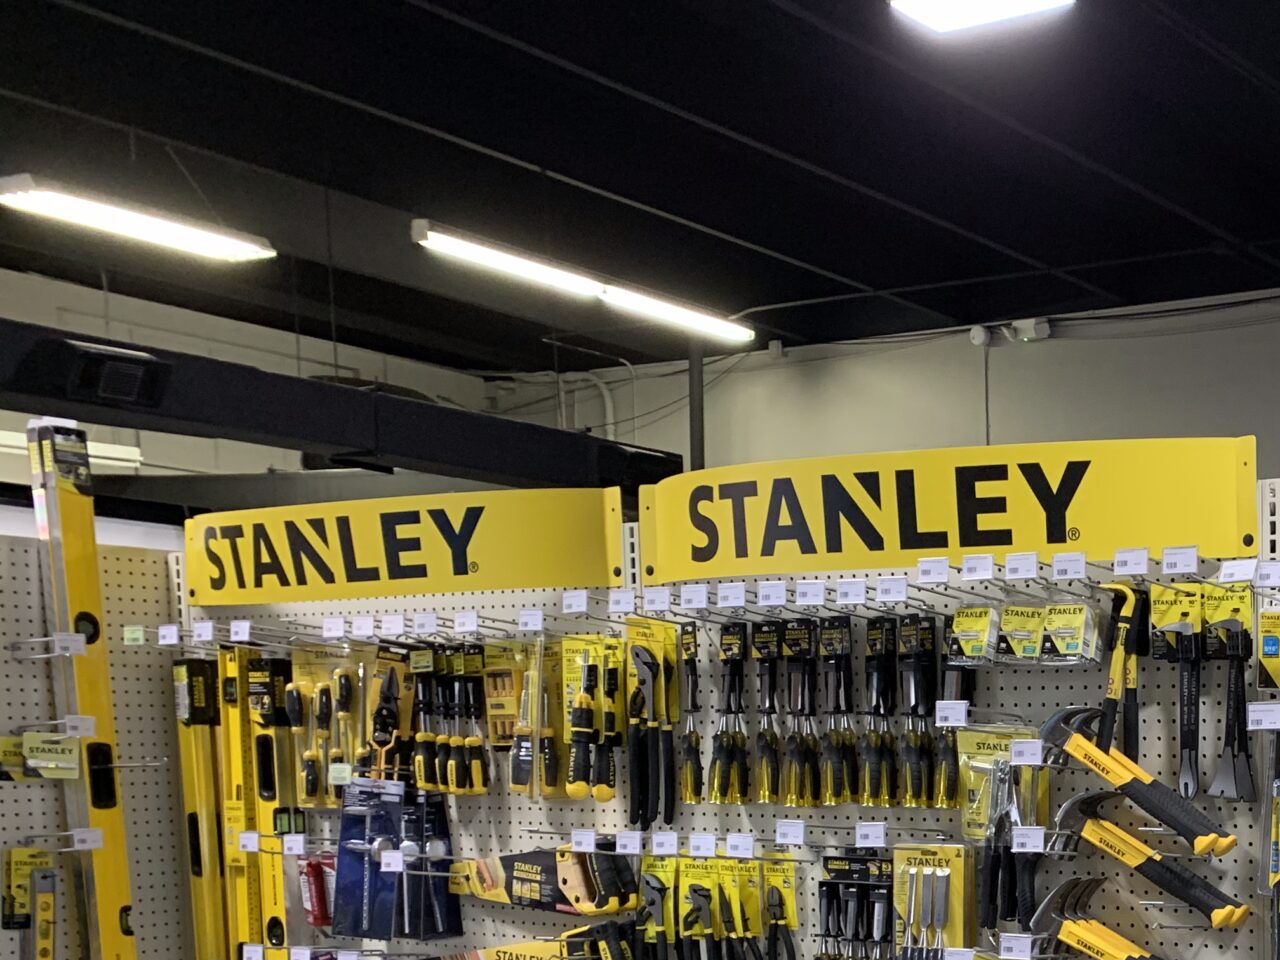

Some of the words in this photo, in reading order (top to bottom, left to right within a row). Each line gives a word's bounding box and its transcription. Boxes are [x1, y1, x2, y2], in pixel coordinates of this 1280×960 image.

[690, 459, 1080, 563] STANLEY
[205, 504, 472, 591] STANLEY
[956, 610, 988, 618] STANLEY
[1004, 609, 1042, 618] STANLEY
[1048, 607, 1084, 616] STANLEY
[28, 746, 74, 754] STANLEY
[567, 748, 575, 782] STANLEY
[1082, 753, 1110, 776] STANLEY
[1099, 837, 1126, 858] STANLEY
[513, 861, 542, 874] STANLEY
[906, 857, 951, 867] STANLEY
[1076, 938, 1104, 959] STANLEY
